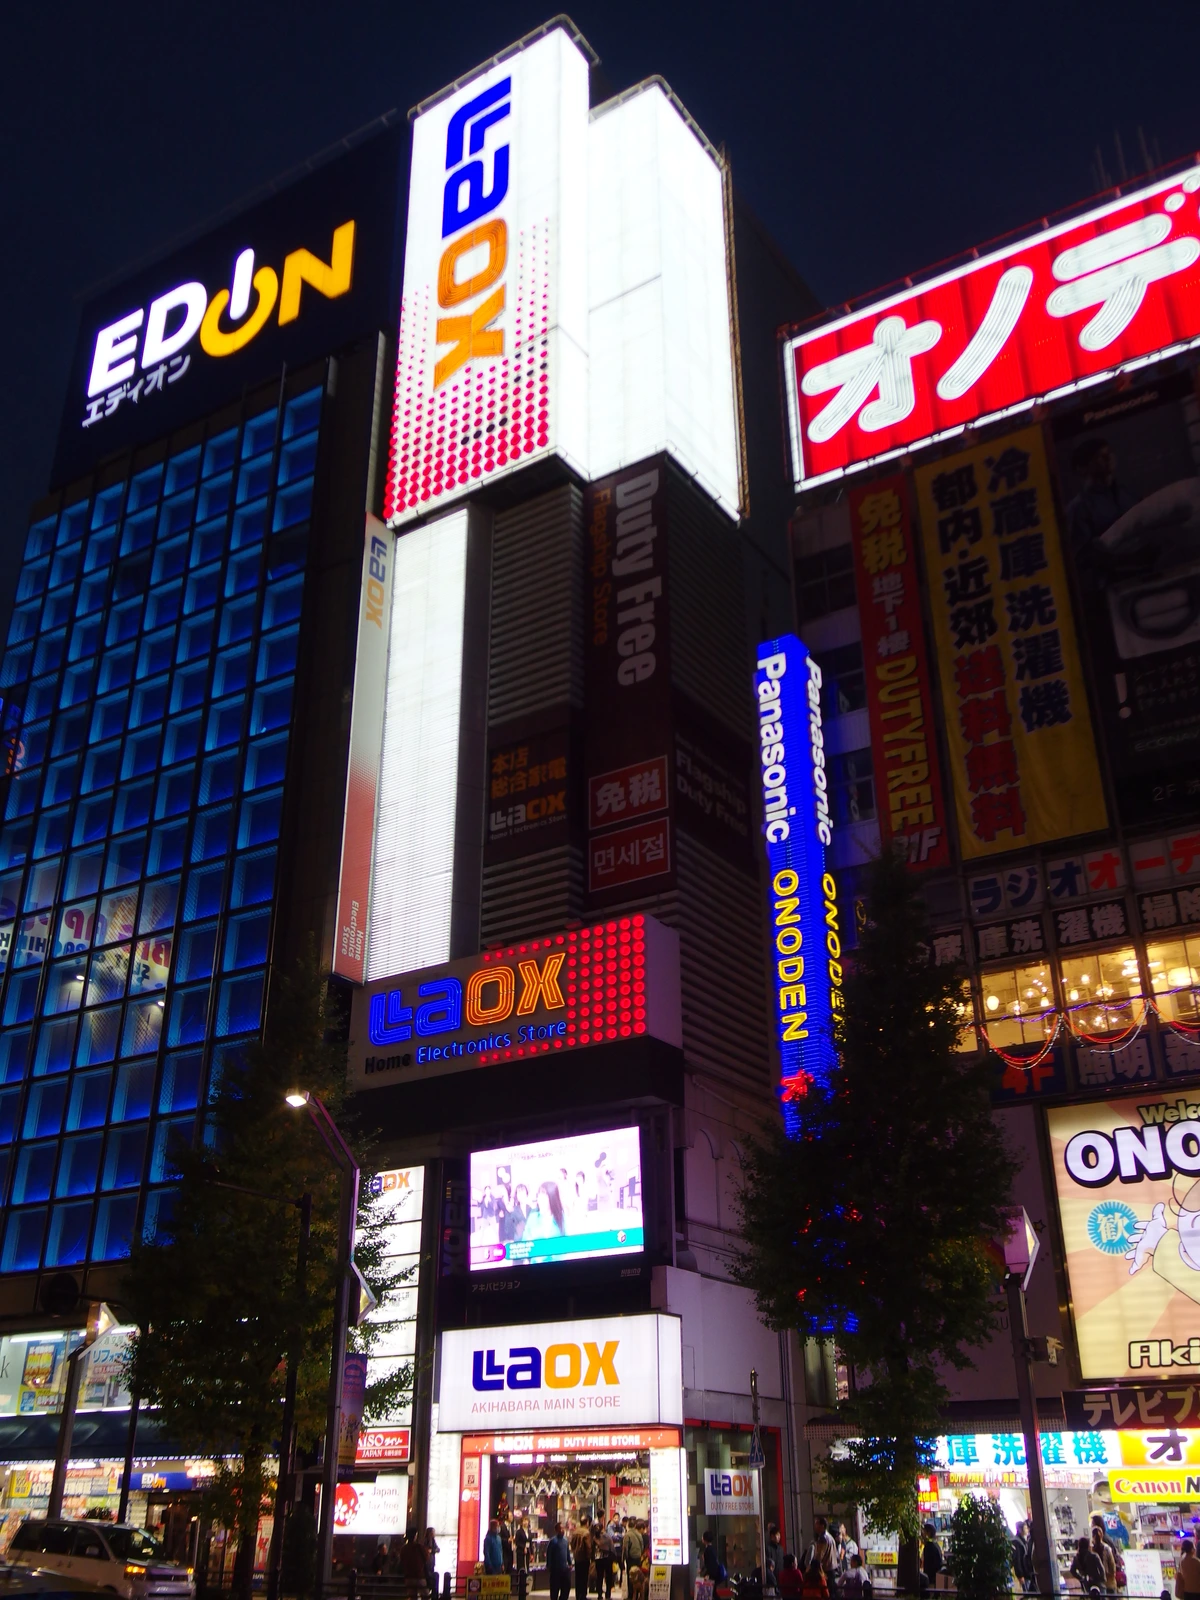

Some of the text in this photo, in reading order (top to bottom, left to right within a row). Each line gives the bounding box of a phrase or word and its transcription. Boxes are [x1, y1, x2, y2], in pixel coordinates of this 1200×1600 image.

[87, 219, 356, 398] EDION
[82, 354, 191, 428] エディオン
[612, 468, 663, 687] Duty Free
[984, 446, 1073, 732] 冷蔵庫洗濯機
[593, 582, 612, 646] Store
[757, 651, 798, 844] Panasonic
[805, 655, 834, 847] Panasonic
[595, 768, 663, 818] 免税
[1152, 783, 1177, 802] 2F
[593, 832, 665, 876] 면세점
[971, 861, 1082, 914] ラジオ
[341, 926, 351, 956] Store
[348, 900, 360, 958] Electronics
[355, 930, 364, 961] Home
[772, 868, 809, 1042] ONODEN
[365, 1020, 568, 1075] Home Electronics Store
[1138, 1100, 1200, 1125] Welc
[1097, 1212, 1131, 1244] 歓
[471, 1395, 621, 1414] AKIHABARA MAIN STORE
[362, 1449, 383, 1458] JAPAN
[563, 1436, 587, 1448] DUTY
[587, 1435, 610, 1447] FREE
[611, 1434, 640, 1446] STORE
[711, 1502, 755, 1511] DUTY FREE STORE
[1114, 1478, 1181, 1494] Canon
[1186, 1476, 1200, 1493] N
